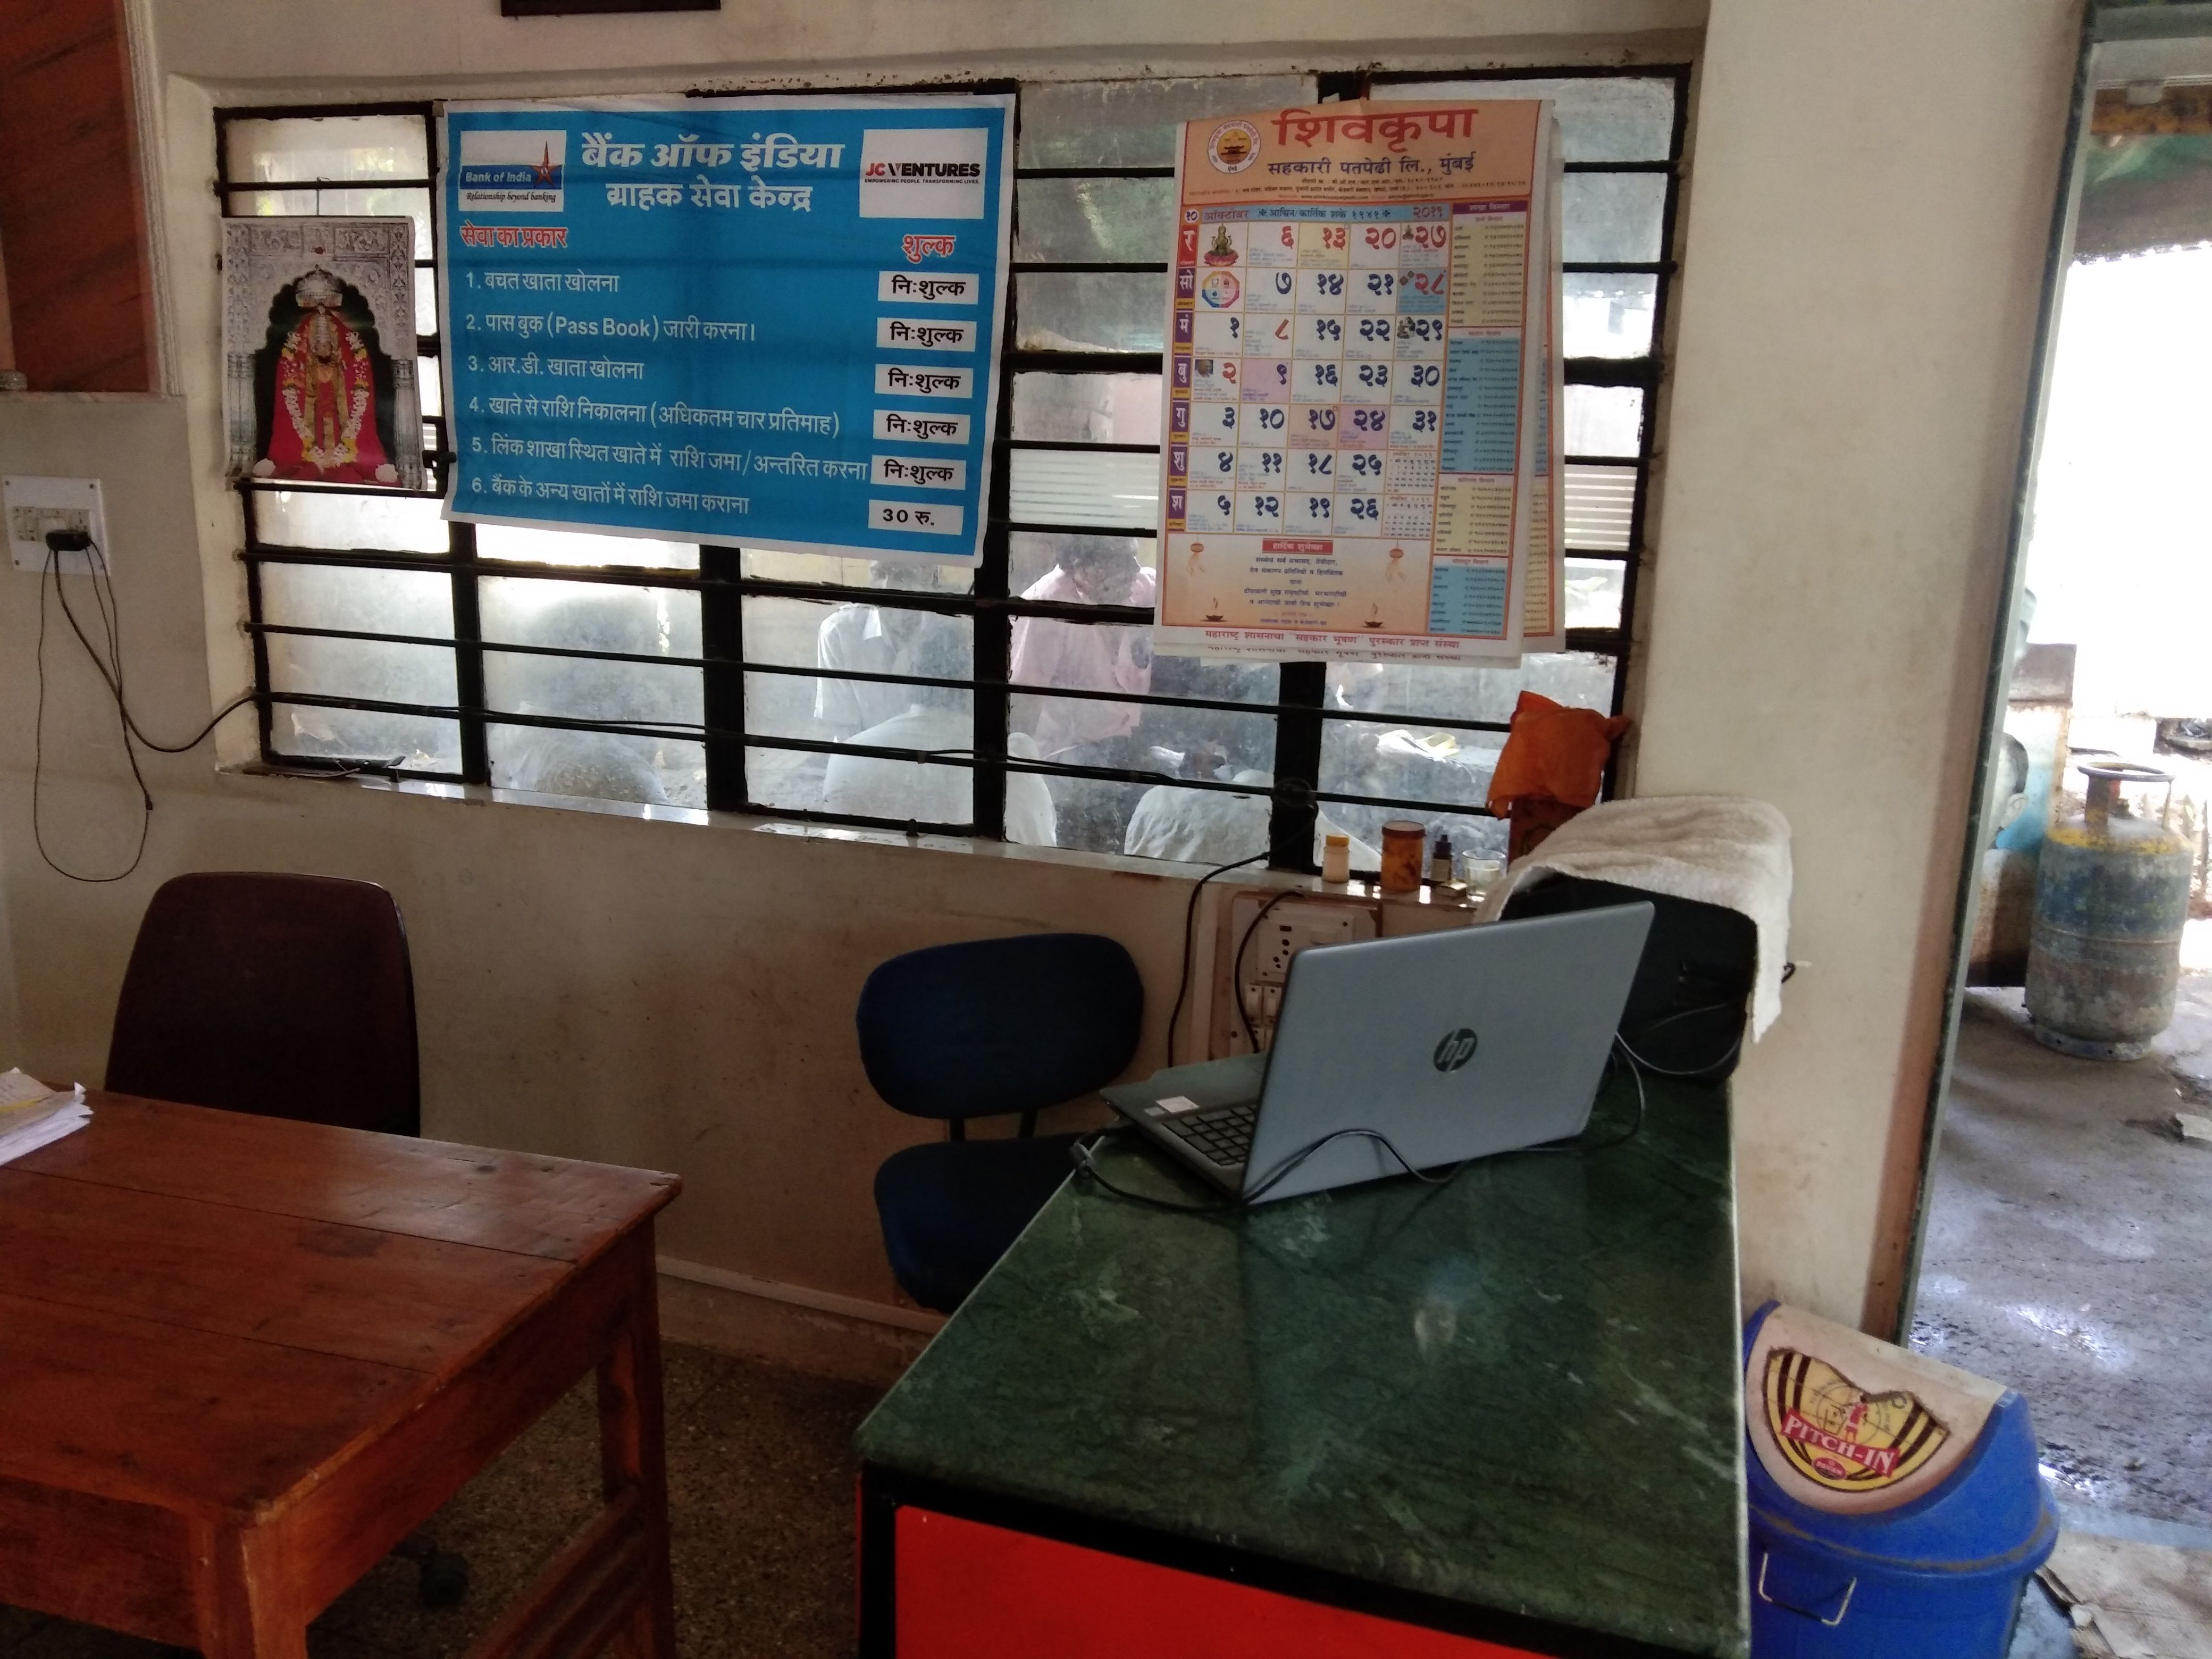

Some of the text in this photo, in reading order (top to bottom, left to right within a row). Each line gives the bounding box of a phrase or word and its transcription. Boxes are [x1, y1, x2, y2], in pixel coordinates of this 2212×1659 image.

[1271, 108, 1479, 153] शिवकृपा
[582, 132, 845, 172] बैंक ऑफ इंडिया
[866, 163, 980, 177] JC VENTURES
[1268, 157, 1331, 174] सहकारी
[1340, 157, 1391, 174] पतपेढी
[1440, 152, 1476, 175] मुंबई
[466, 172, 531, 182] Bank of India
[467, 191, 556, 203] Relationship beyond banking
[606, 174, 813, 212] ग्राहक सेवा केन्द्र
[1204, 211, 1249, 221] ऑक्टोबर
[1299, 208, 1326, 217] कार्तिक
[1331, 209, 1346, 218] शके
[460, 219, 568, 248] सेवा का प्रकार
[1281, 226, 1294, 249] ६
[1323, 228, 1345, 250] १३
[1365, 228, 1396, 249] २०
[1415, 225, 1446, 248] २७
[902, 234, 956, 263] शुल्क
[484, 272, 519, 290] बचत
[522, 273, 561, 291] खाता
[564, 270, 619, 292] खोलना
[1180, 270, 1194, 290] सो
[1276, 272, 1292, 295] ७
[1317, 274, 1344, 295] १४
[1368, 274, 1394, 296] २१
[1415, 270, 1446, 295] २८
[486, 314, 514, 331] पास
[518, 315, 544, 339] बुक
[664, 315, 699, 339] जारी
[1179, 314, 1190, 333] मं
[1230, 317, 1239, 339] १
[1275, 319, 1289, 340] ८
[1317, 320, 1341, 341] १५
[1360, 320, 1390, 341] २२
[1416, 319, 1443, 341] २९
[548, 358, 587, 377] खाता
[590, 355, 643, 379] खोलना
[1178, 363, 1187, 383] बु
[1222, 362, 1236, 384] २
[1277, 364, 1287, 384] ९
[1315, 364, 1338, 386] १६
[1359, 365, 1388, 387] २३
[1411, 365, 1439, 387] ३०
[489, 393, 522, 415] खाते
[524, 395, 538, 416] से
[542, 395, 574, 418] राशि
[577, 396, 647, 422] निकालना
[737, 411, 764, 428] चार
[1176, 407, 1186, 427] गु
[1222, 407, 1235, 429] ३
[1260, 408, 1285, 429] १०
[1309, 409, 1335, 430] १७
[1354, 409, 1385, 431] २४
[1413, 410, 1436, 432] ३१
[491, 432, 523, 456] लिंक
[527, 440, 565, 459] शाखा
[569, 438, 608, 462] स्थित
[613, 442, 646, 465] खाते
[650, 443, 662, 466] में
[670, 445, 705, 468] राशि
[753, 452, 820, 477] अन्तरित
[823, 460, 868, 480] करना
[1174, 451, 1185, 471] शु
[1218, 452, 1233, 472] ४
[1262, 453, 1281, 473] ११
[1309, 454, 1332, 474] १८
[1352, 454, 1381, 475] २५
[492, 473, 516, 495] बैंक
[519, 475, 532, 497] के
[536, 482, 568, 500] अन्य
[572, 482, 610, 504] खातों
[614, 482, 625, 504] में
[629, 483, 663, 508] राशि
[666, 491, 698, 510] जमा
[702, 493, 749, 514] कराना
[1171, 495, 1183, 510] श
[883, 509, 909, 522] 30
[1217, 495, 1230, 515] ५
[1255, 496, 1279, 517] १२
[1310, 498, 1329, 518] १९
[1351, 498, 1379, 520] २६
[1205, 630, 1239, 640] महाराष्ट्र
[1245, 632, 1284, 640] शासनाचा
[1369, 638, 1404, 647] पुरस्कार
[1410, 639, 1429, 647] प्राप्त
[1434, 639, 1459, 648] संस्था
[1784, 1414, 1896, 1475] PITCH-IN
